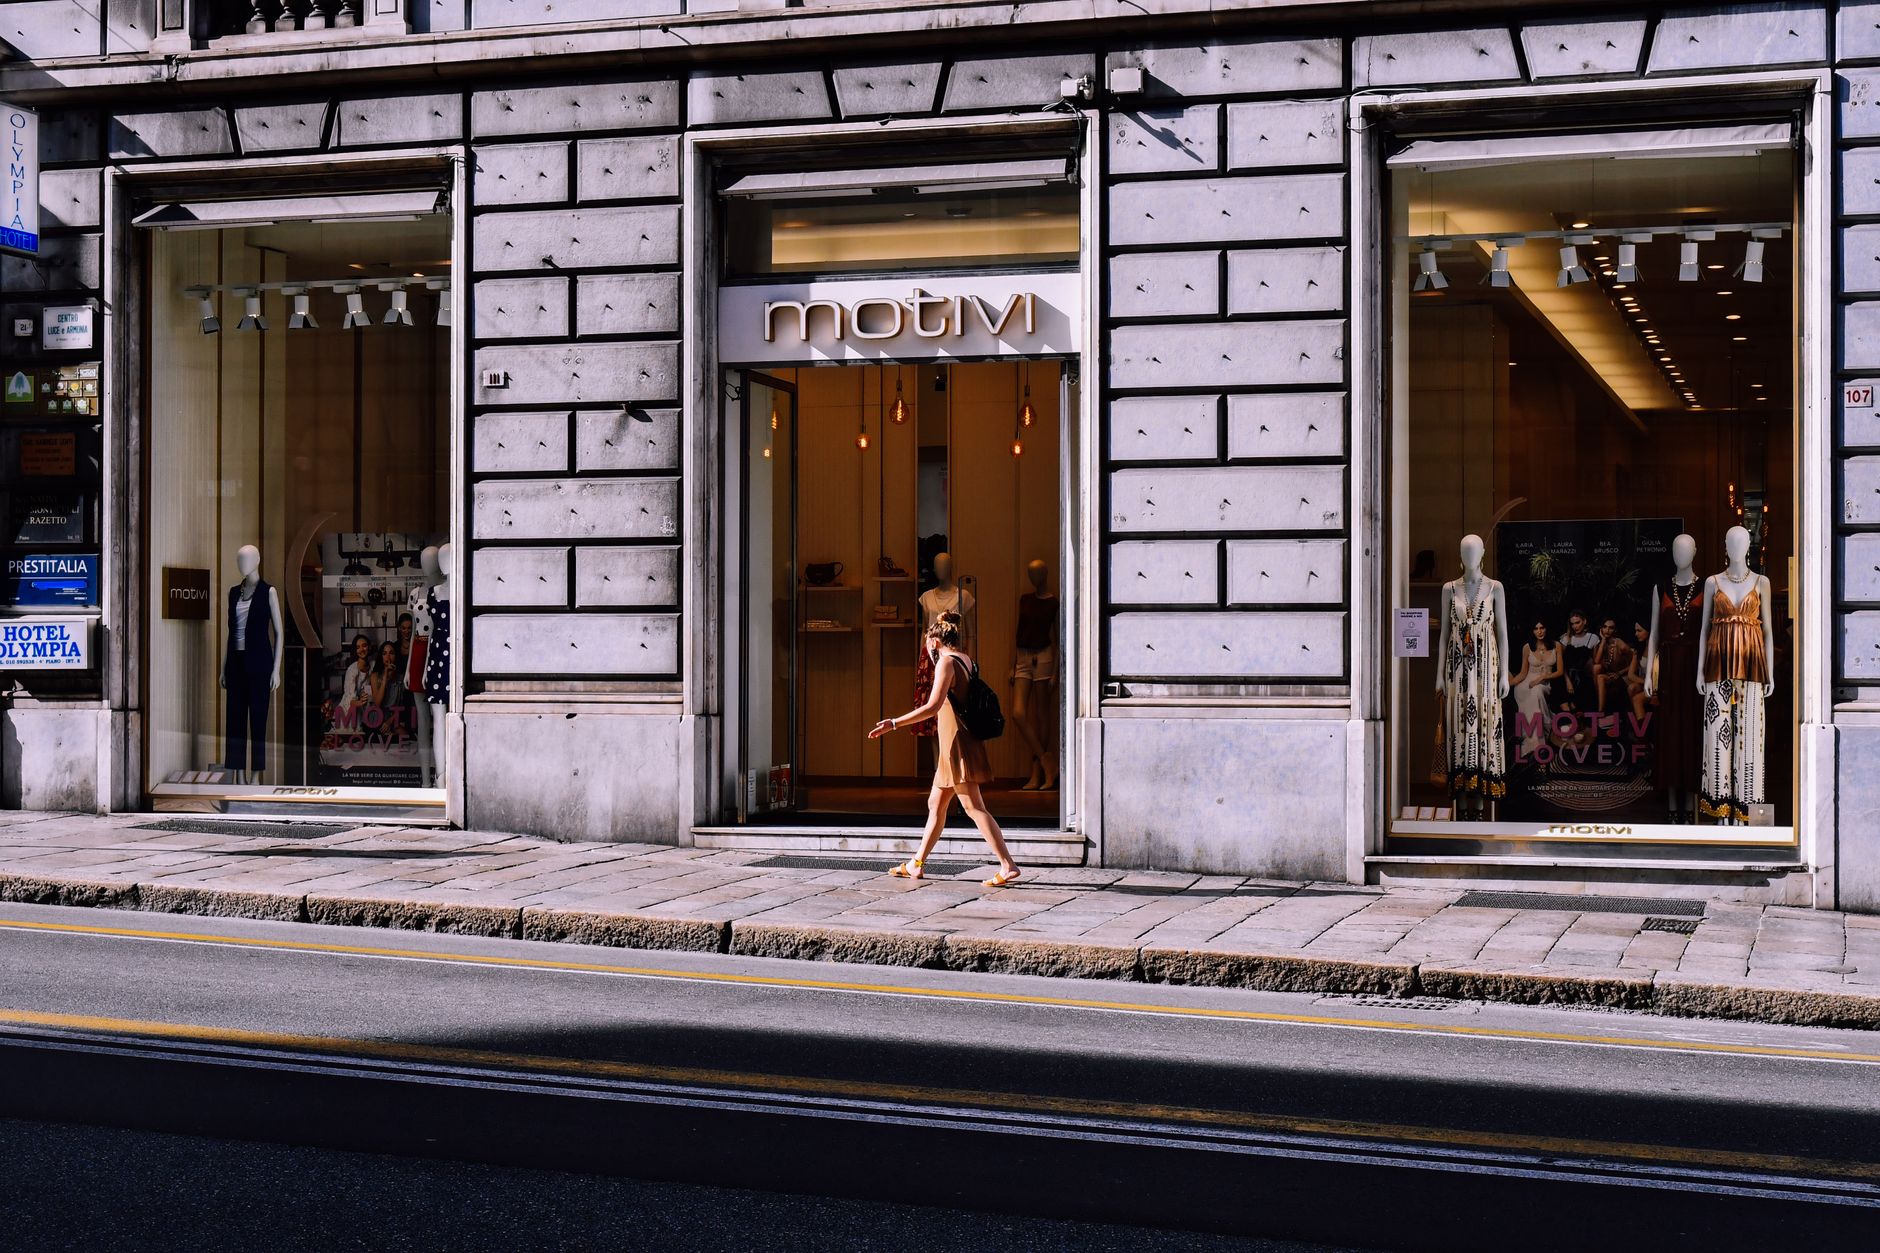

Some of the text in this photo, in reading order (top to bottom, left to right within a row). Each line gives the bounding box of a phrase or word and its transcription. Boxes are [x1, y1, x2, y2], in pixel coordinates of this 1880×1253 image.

[10, 113, 26, 230] OLYMPIA
[0, 228, 36, 251] HOTEL
[57, 313, 79, 323] CENTRO
[763, 288, 1037, 342] motivi
[48, 326, 60, 335] LUCE
[66, 325, 88, 334] ARMONIA
[1846, 389, 1870, 403] 107
[29, 516, 67, 525] RAZETTO
[8, 559, 88, 573] PRESTITALIA
[170, 586, 208, 600] motivi
[3, 625, 70, 642] HOTEL
[272, 787, 339, 796] motivi
[1548, 824, 1633, 835] motivi
